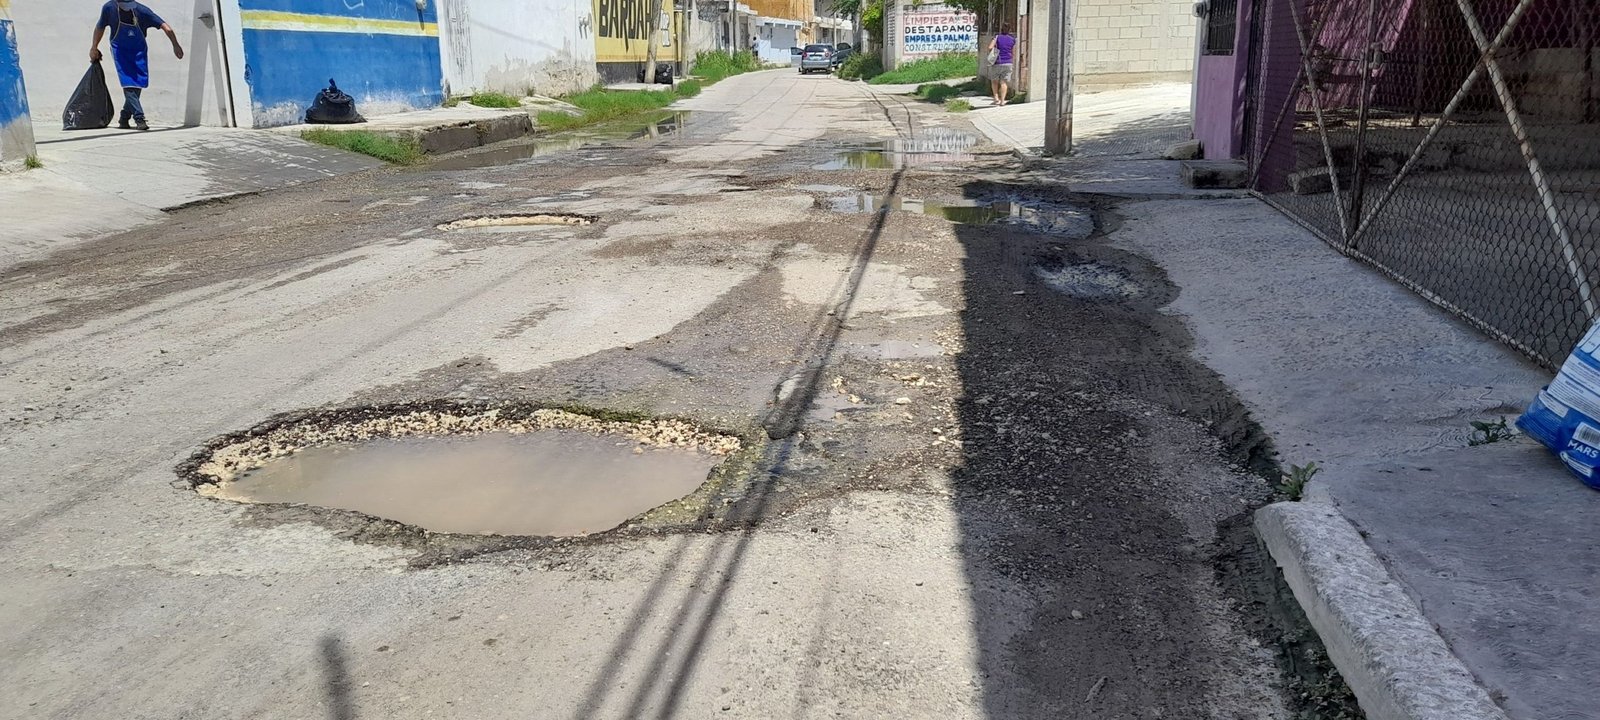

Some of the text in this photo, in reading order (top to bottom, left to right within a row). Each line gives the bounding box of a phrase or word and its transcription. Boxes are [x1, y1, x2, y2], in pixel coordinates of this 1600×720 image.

[905, 16, 955, 25] LIMPIEZA
[905, 25, 978, 34] DESTAPAMOS
[905, 35, 942, 43] EMPRESA
[943, 34, 969, 42] PALMA
[1568, 439, 1599, 458] MARS
